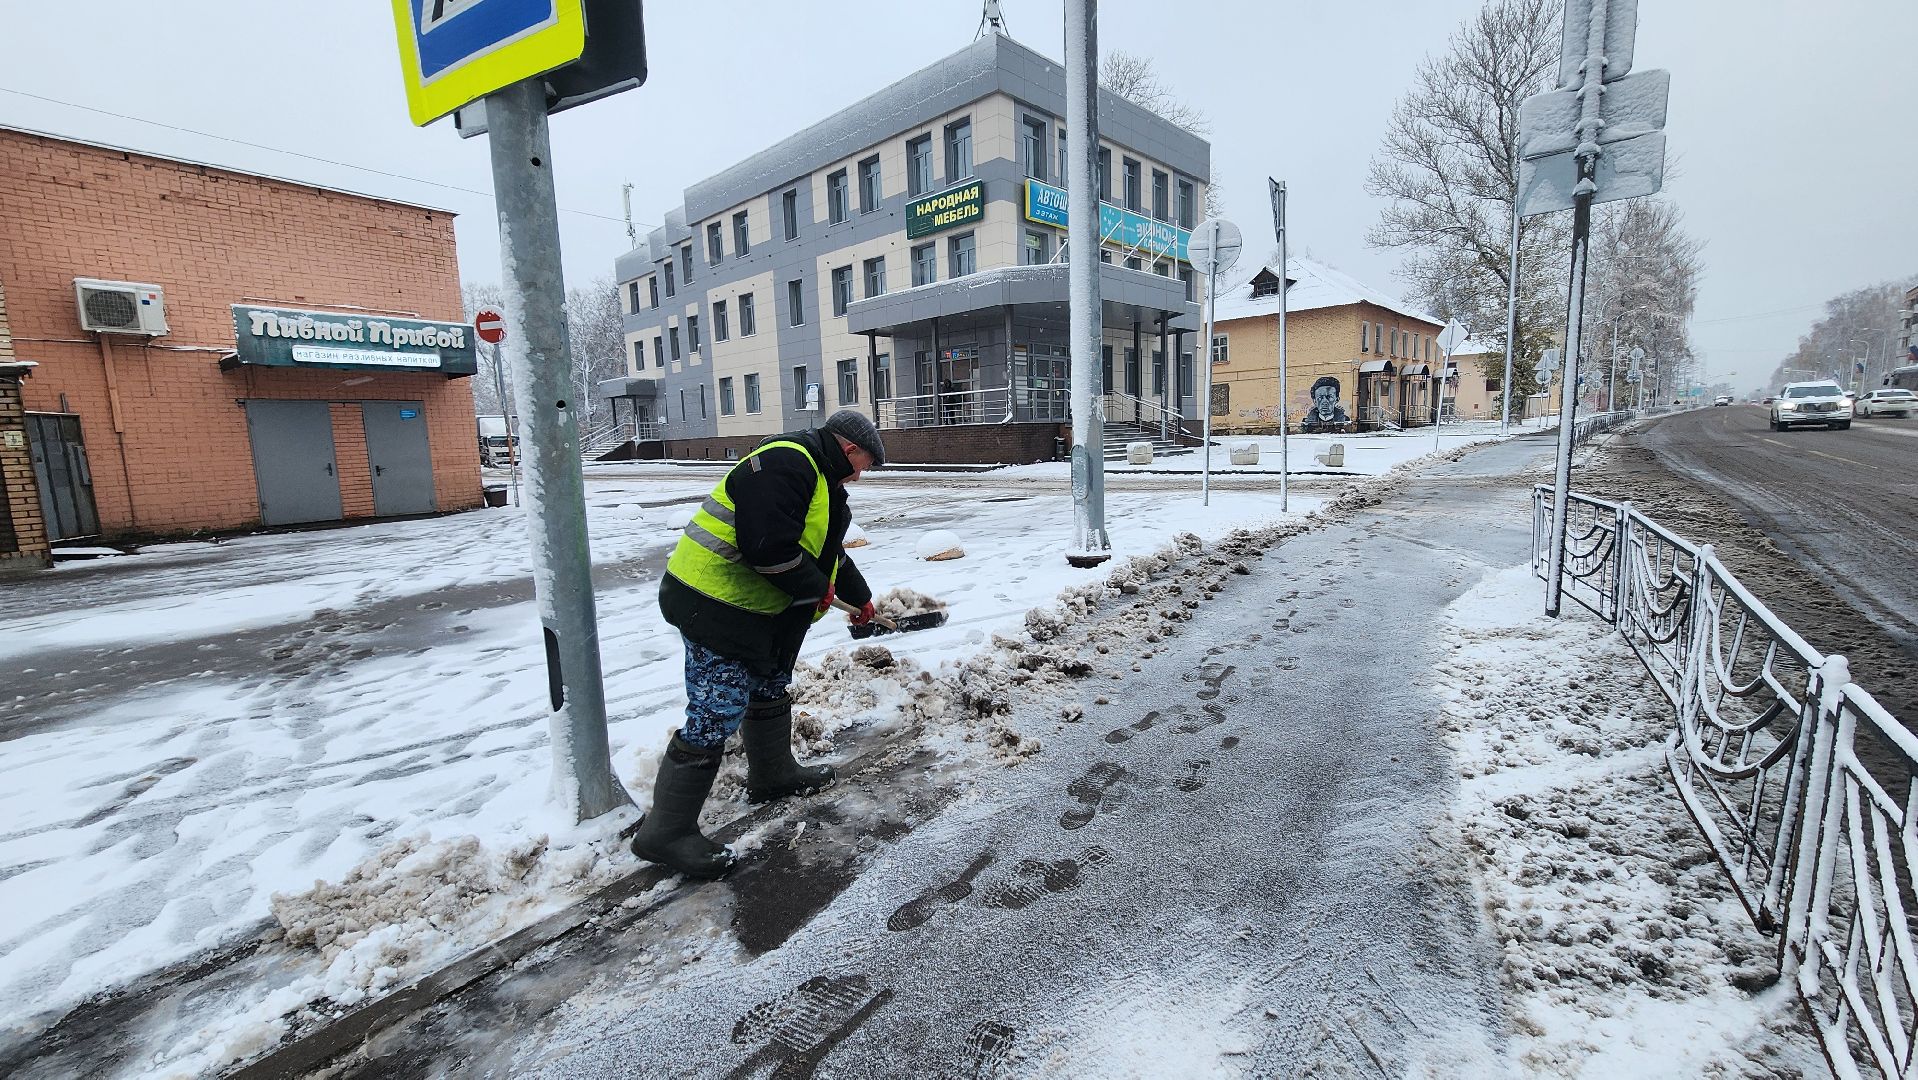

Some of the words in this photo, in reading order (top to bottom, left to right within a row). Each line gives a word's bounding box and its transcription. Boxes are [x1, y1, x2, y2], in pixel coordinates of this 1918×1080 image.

[916, 186, 979, 216] НАРОДНАЯ
[934, 204, 979, 226] МЕБЕЛЬ
[1041, 210, 1059, 220] ЭТАЖ
[248, 310, 364, 343] Пивной
[367, 320, 465, 348] Прибой
[297, 351, 338, 359] магазин
[343, 353, 393, 362] разливных
